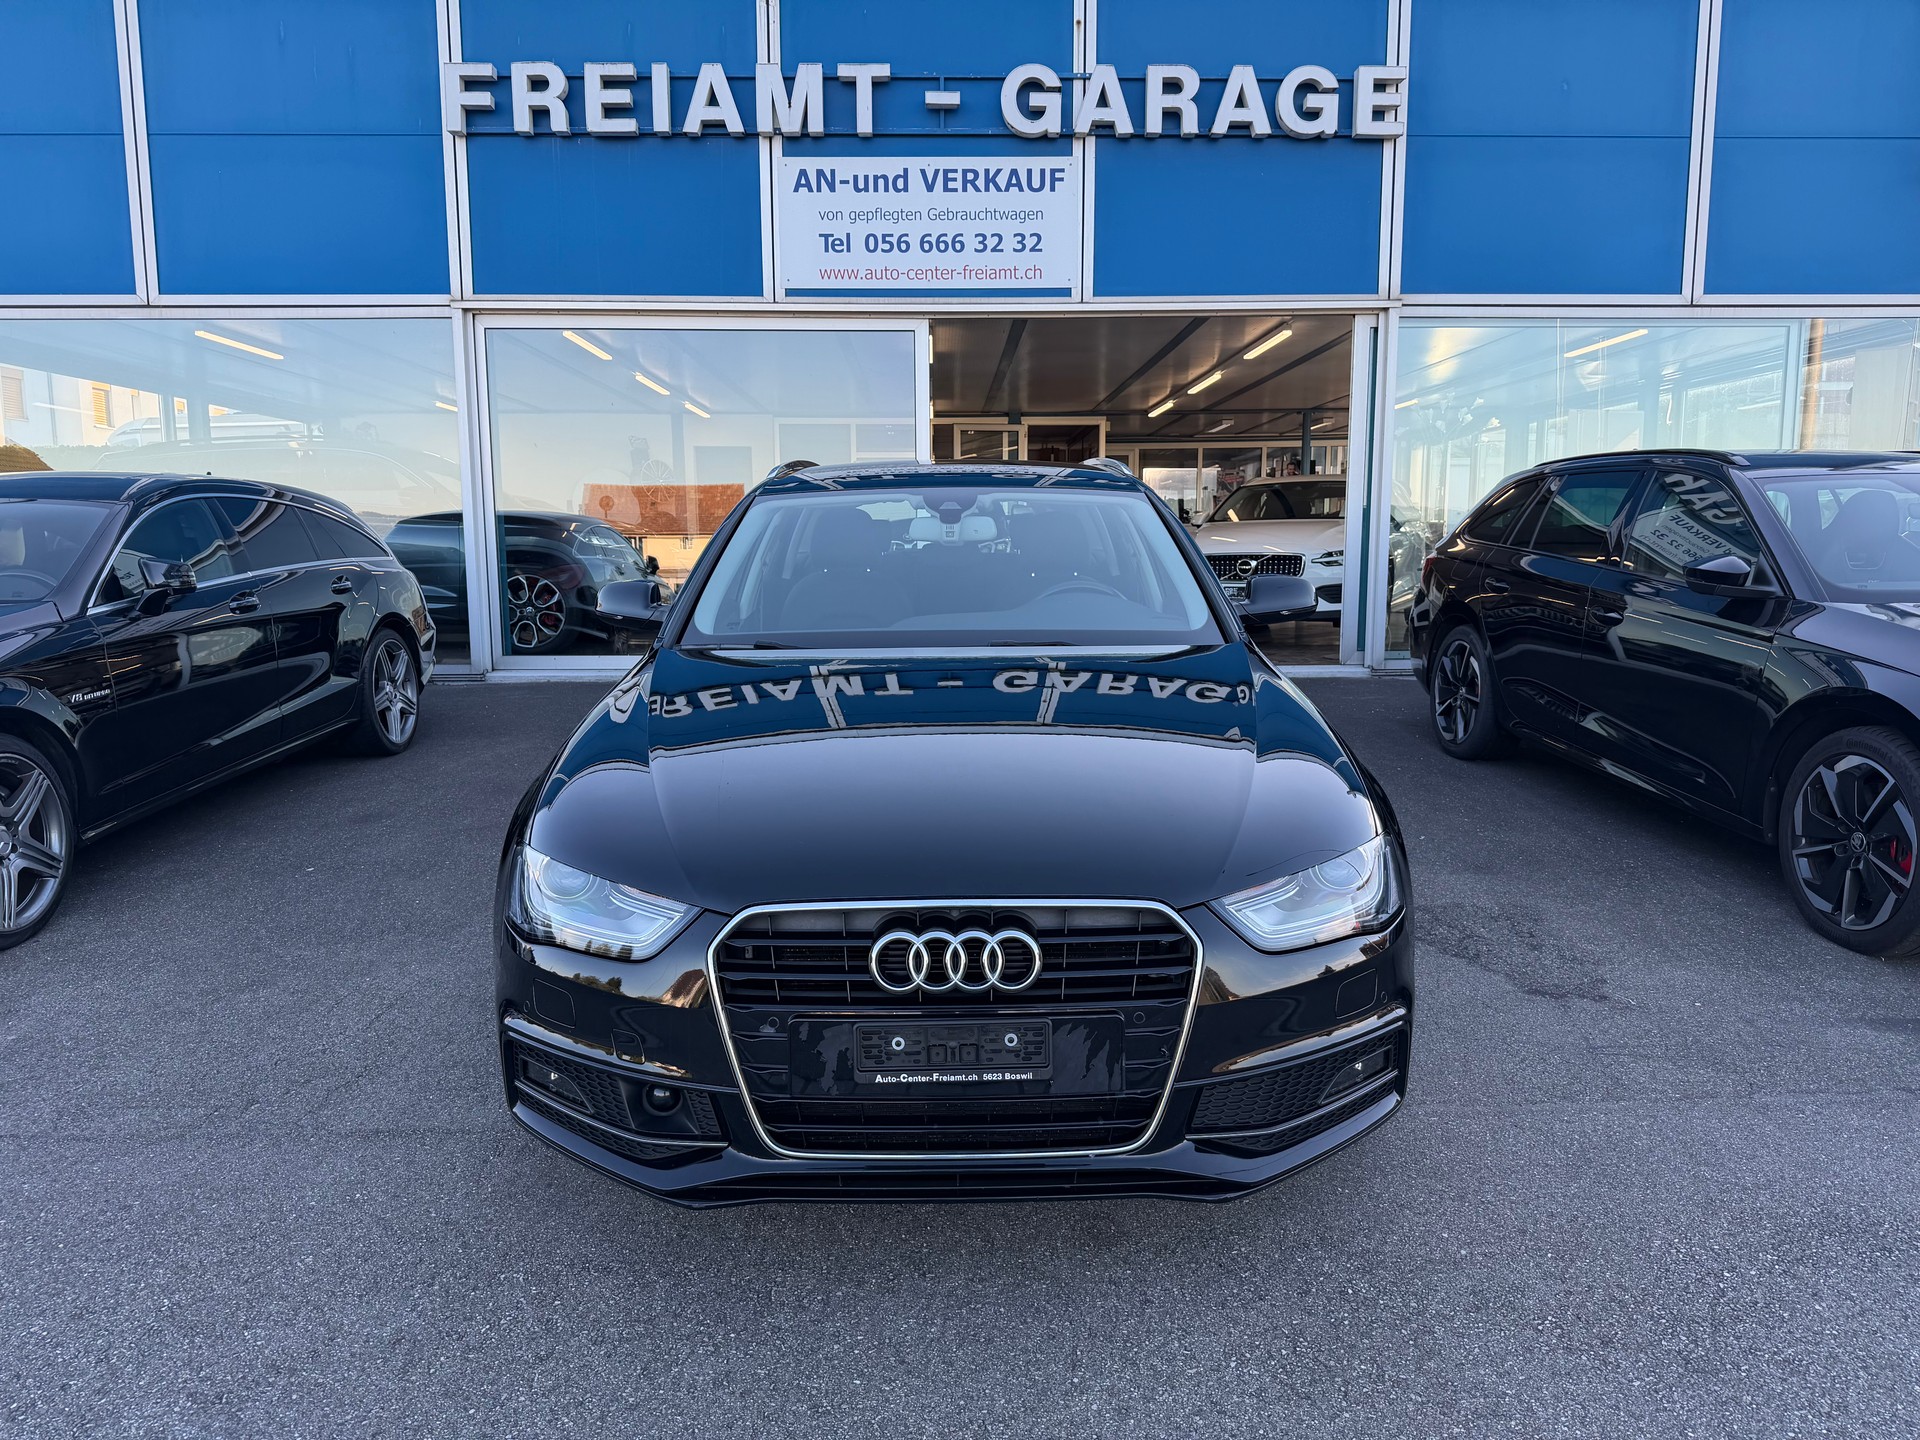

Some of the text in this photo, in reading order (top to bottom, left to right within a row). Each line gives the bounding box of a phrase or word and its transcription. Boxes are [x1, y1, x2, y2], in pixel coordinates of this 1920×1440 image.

[443, 61, 892, 138] FREIAMT
[1000, 63, 1408, 139] GARAGE
[793, 167, 1066, 193] AN-und VERKAUF
[818, 207, 1044, 224] von gepflegten Gebrauchtwagen
[818, 232, 1043, 253] Tel 056 666 32 32
[819, 264, 1043, 281] www.auto-center-freiamt.ch
[982, 1072, 1003, 1081] 5623
[1004, 1071, 1033, 1081] Boswil
